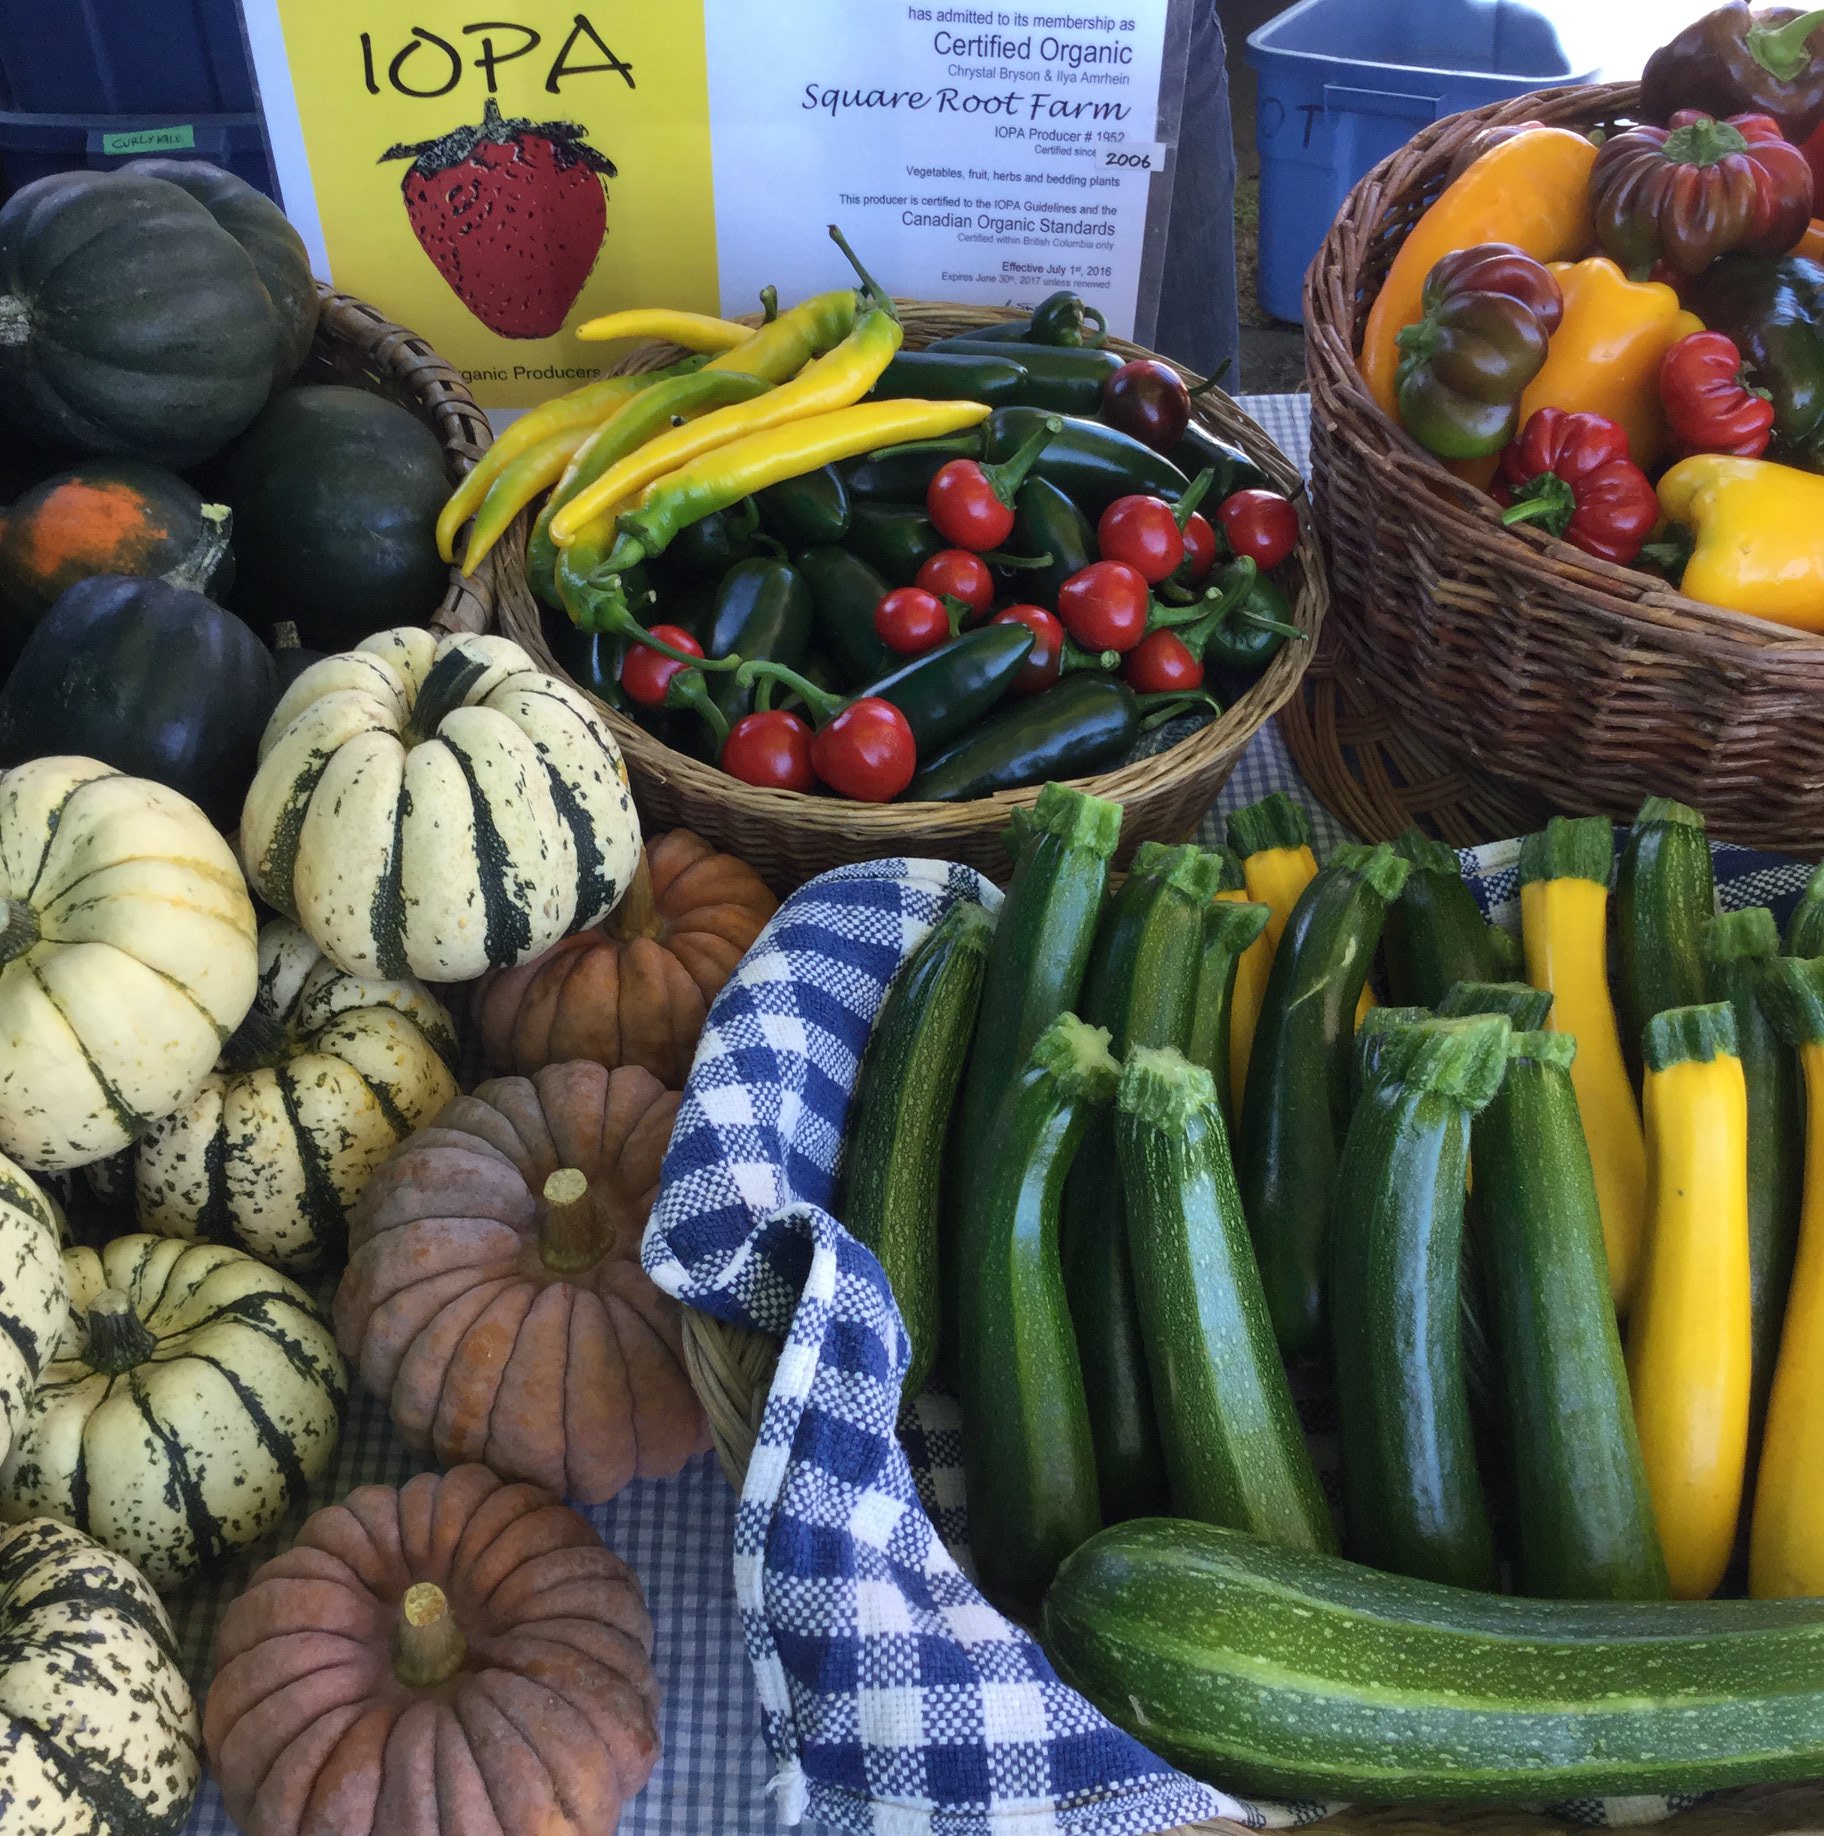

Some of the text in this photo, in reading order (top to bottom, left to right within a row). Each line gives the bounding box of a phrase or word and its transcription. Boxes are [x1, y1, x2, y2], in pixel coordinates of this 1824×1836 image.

[908, 6, 1135, 33] has admitted to its membership as
[360, 14, 636, 98] IOPA
[934, 31, 1133, 69] Certified Organic
[948, 64, 996, 80] Chrystal
[1000, 67, 1040, 83] Bryson
[1044, 70, 1053, 82] &
[1080, 71, 1130, 86] Amrhein
[802, 83, 1132, 121] Square Root Farm
[995, 126, 1125, 143] IOPA Producer # 1952
[1034, 145, 1072, 156] Certified
[1105, 152, 1152, 169] 2006
[906, 165, 1120, 188] Vegetables, fruit, herbs and bedding plants
[839, 194, 1118, 216] This producer is certified to the IOPA Guidelines and the
[902, 211, 1116, 237] Canadian Organic Standards
[957, 232, 1115, 251] Certified within British Columbia only
[1002, 261, 1044, 274] Effective
[1046, 263, 1067, 277] July
[1087, 265, 1112, 277] 2016
[941, 271, 974, 283] Expires
[975, 273, 997, 284] June
[1019, 276, 1041, 286] 2017
[1043, 277, 1072, 288] unless
[1073, 279, 1111, 290] renewed
[458, 365, 601, 384] ganic Producers
